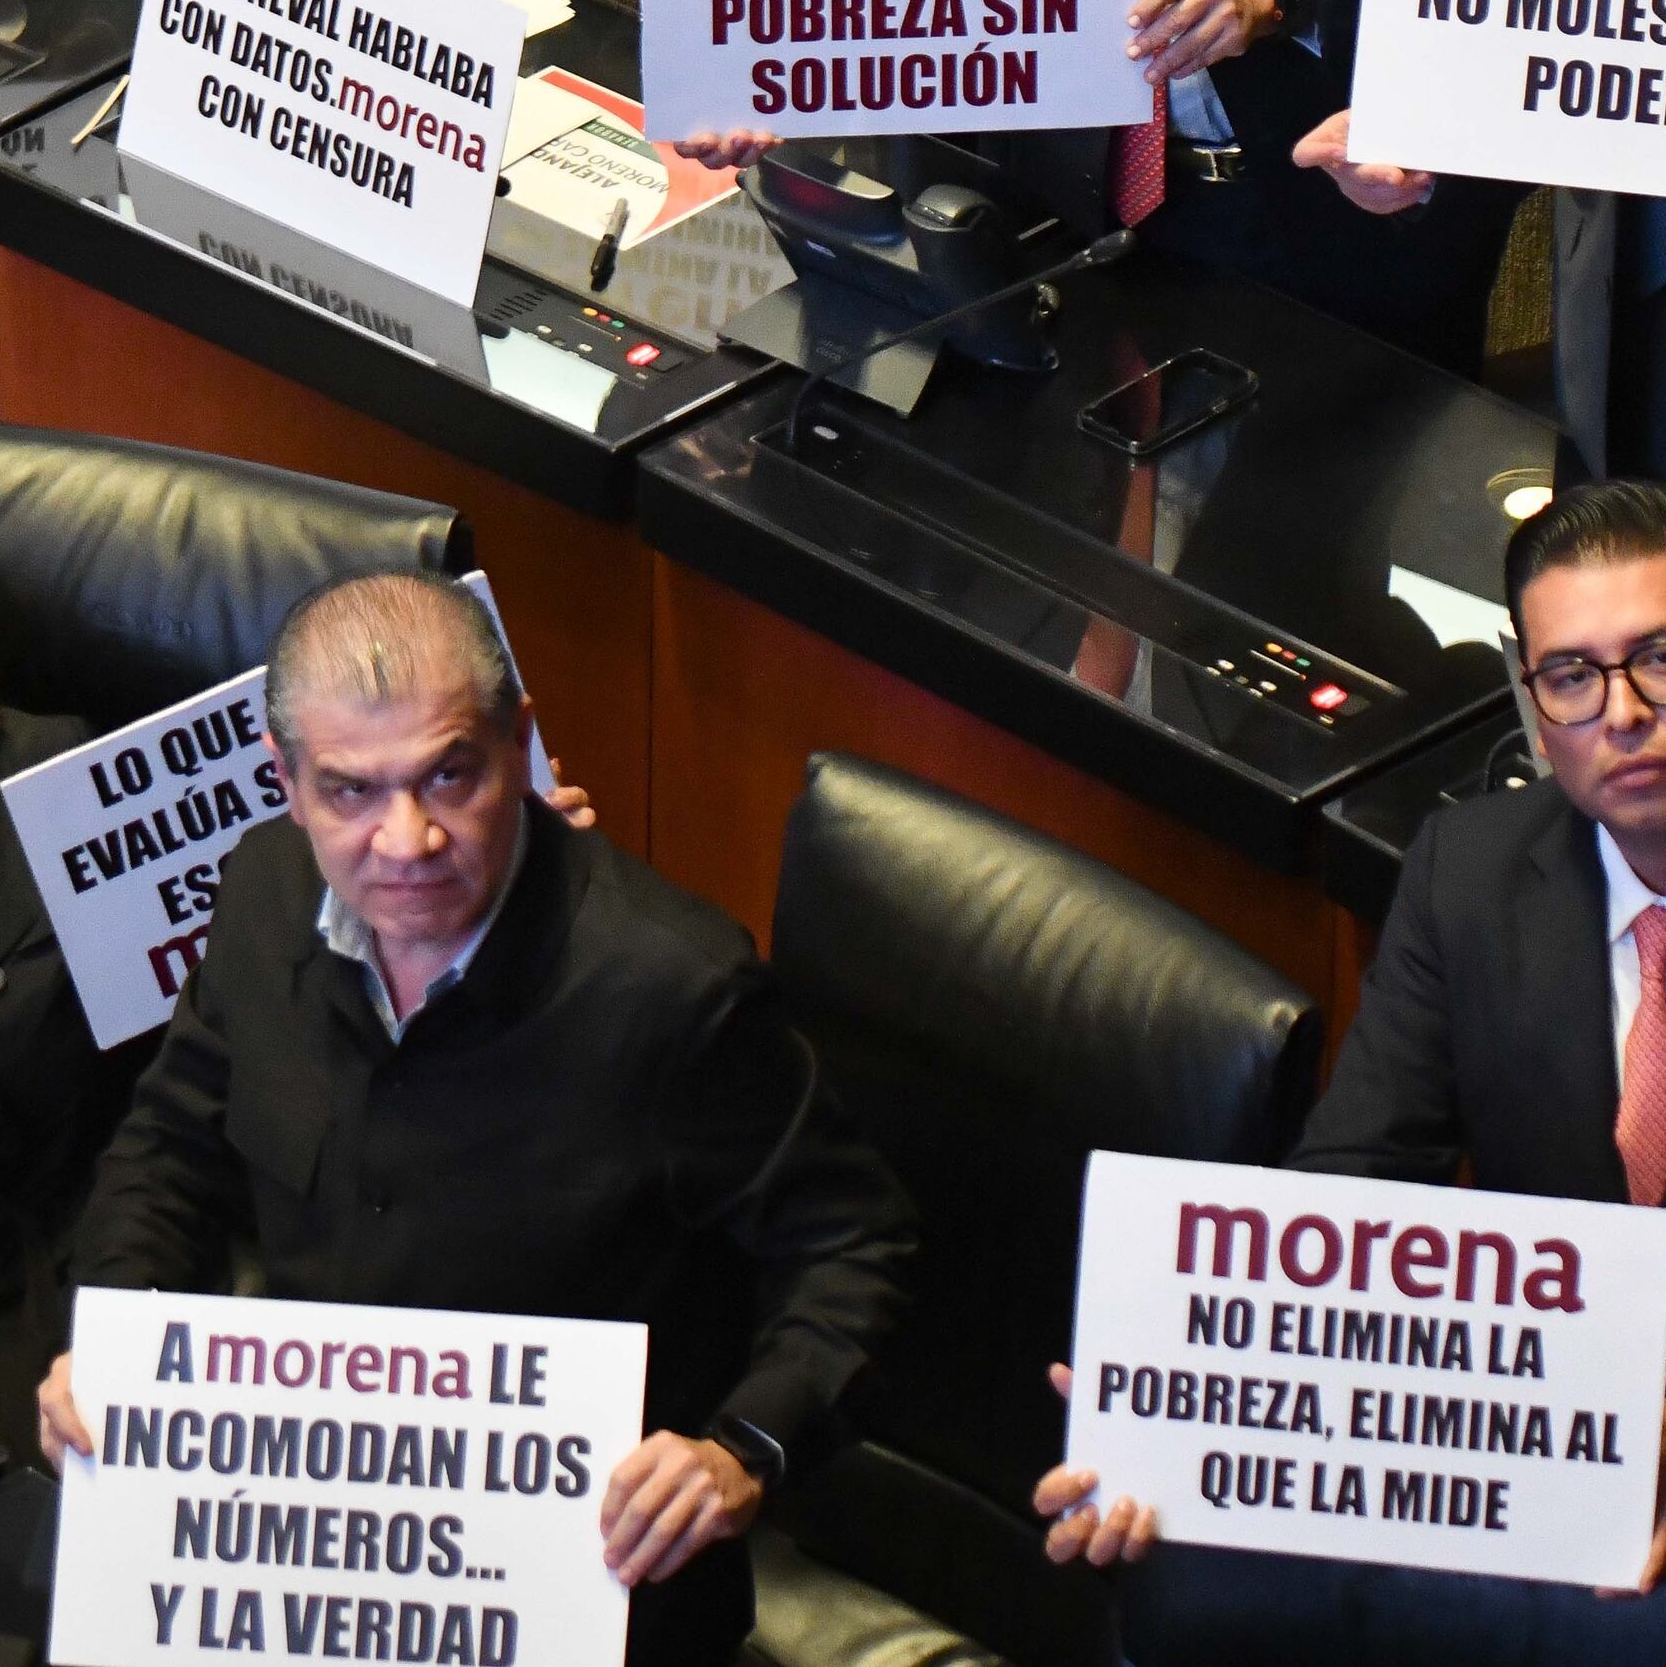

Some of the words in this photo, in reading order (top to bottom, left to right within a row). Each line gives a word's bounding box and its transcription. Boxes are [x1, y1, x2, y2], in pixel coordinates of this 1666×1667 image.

[349, 7, 493, 108] HABLABA
[752, 42, 1037, 114] SOLUCIÓN
[199, 76, 264, 138] CON
[270, 107, 414, 208] CENSURA
[532, 148, 620, 188] ALEJAND
[588, 154, 671, 193] MORENO
[90, 748, 153, 808] LO
[160, 698, 262, 777] QUE
[62, 779, 252, 894] EVALÚA
[1177, 1204, 1584, 1313] morena
[156, 1323, 192, 1382] A
[207, 1336, 470, 1398] morena
[490, 1344, 546, 1406] LE
[1188, 1294, 1254, 1349] NO
[1270, 1303, 1472, 1371] ELIMINA
[1488, 1325, 1543, 1378] LA
[103, 1406, 466, 1488] INCOMODAN
[485, 1432, 589, 1497] LOS
[1099, 1363, 1332, 1439] POBREZA,
[1350, 1389, 1552, 1457] ELIMINA
[1566, 1411, 1621, 1464] AL
[174, 1491, 505, 1580] NÚMEROS...
[1201, 1452, 1296, 1508] QUE
[1311, 1462, 1367, 1516] LA
[1382, 1469, 1509, 1530] MIDE
[151, 1584, 183, 1644] Y
[199, 1588, 264, 1651] LA
[284, 1593, 517, 1667] VERDAD
